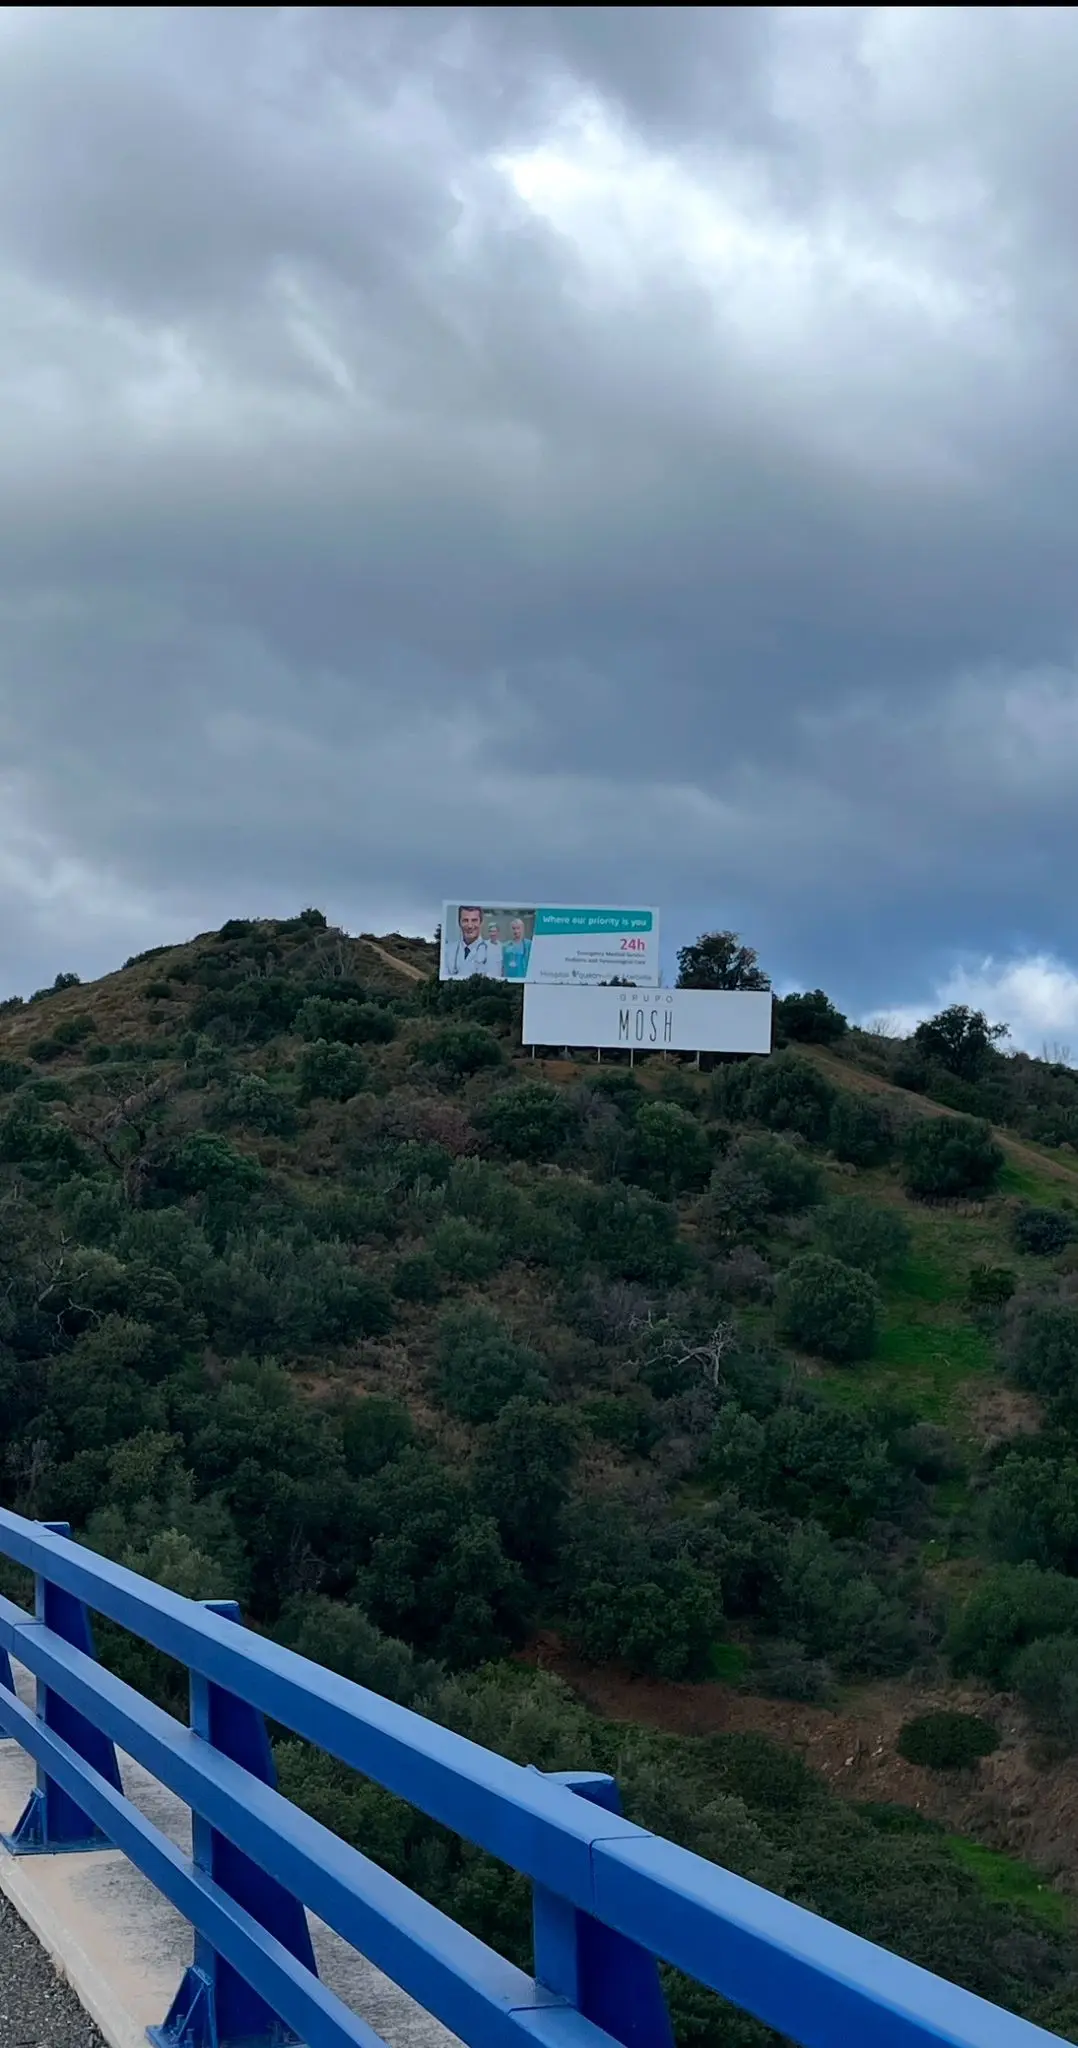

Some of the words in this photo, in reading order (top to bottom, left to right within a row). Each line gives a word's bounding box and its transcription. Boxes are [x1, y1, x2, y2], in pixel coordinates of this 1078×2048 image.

[543, 915, 570, 924] Where
[588, 916, 620, 927] priority
[622, 917, 629, 925] is
[631, 919, 647, 928] you
[620, 938, 645, 951] 24h
[619, 994, 674, 1004] GRUPO
[619, 1009, 673, 1043] MOSH
